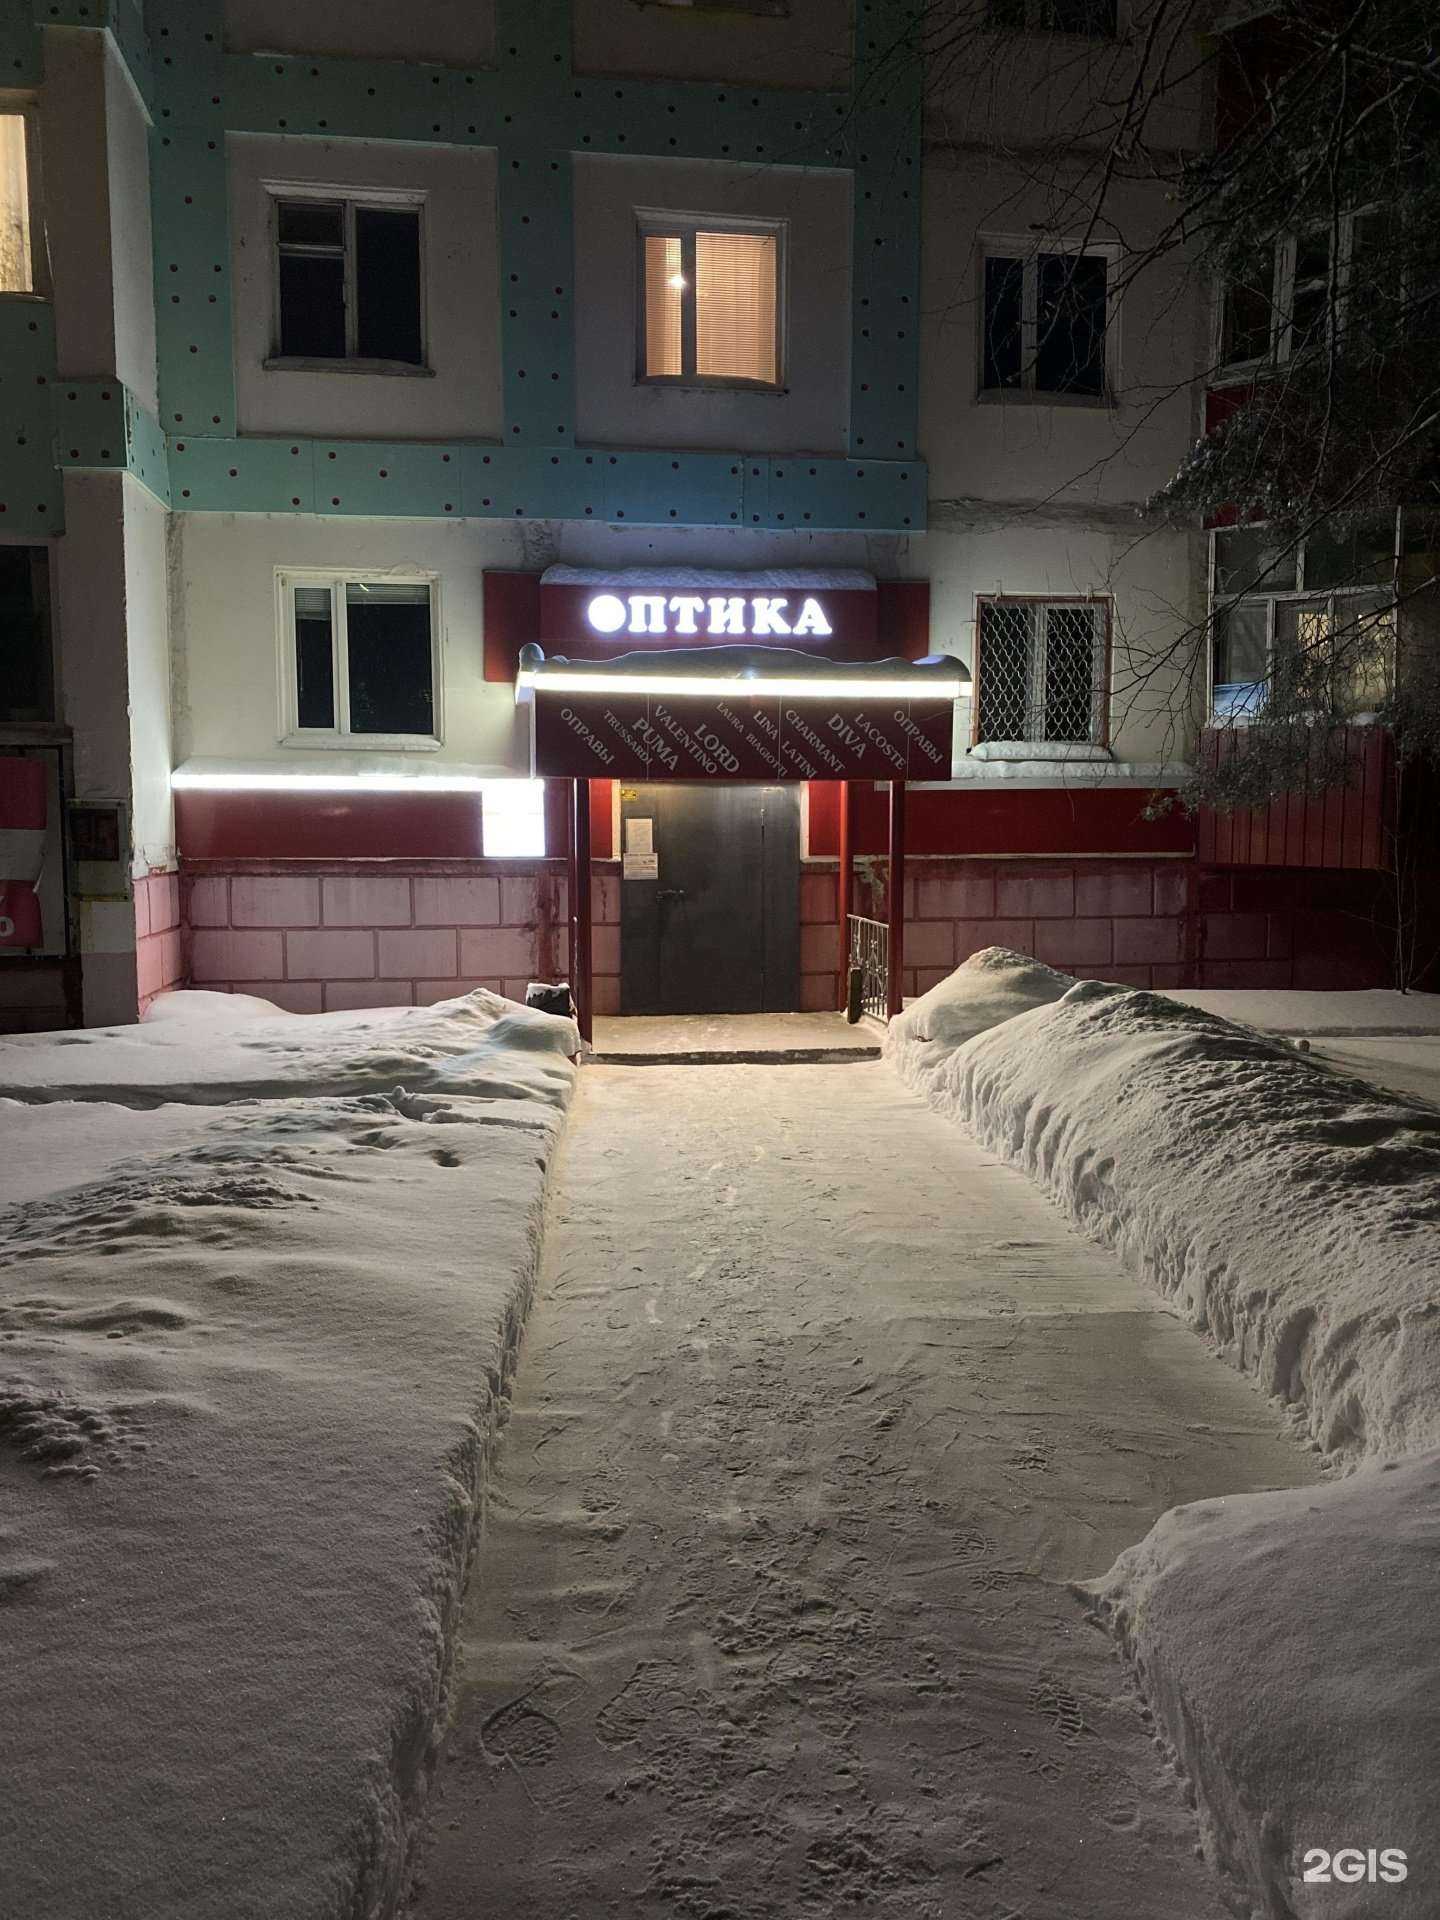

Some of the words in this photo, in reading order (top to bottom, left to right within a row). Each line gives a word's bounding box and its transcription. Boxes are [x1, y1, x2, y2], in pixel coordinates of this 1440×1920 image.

[587, 594, 833, 635] ОПТИКА
[560, 708, 616, 765] ОПРАВЫ
[603, 710, 654, 766] TRUSSARDI
[632, 717, 681, 771] PUMA
[654, 705, 718, 774] VALENTINO
[693, 723, 740, 773] LORD
[715, 701, 745, 734] LAURA
[745, 733, 788, 777] BIAGIOTTI
[753, 710, 779, 740] LINA
[781, 740, 819, 779] LATINI
[785, 709, 846, 773] CHARMANT
[827, 713, 868, 759] DIVA
[854, 713, 907, 770] LACOSTE
[893, 710, 944, 764] ОПРАВЫ
